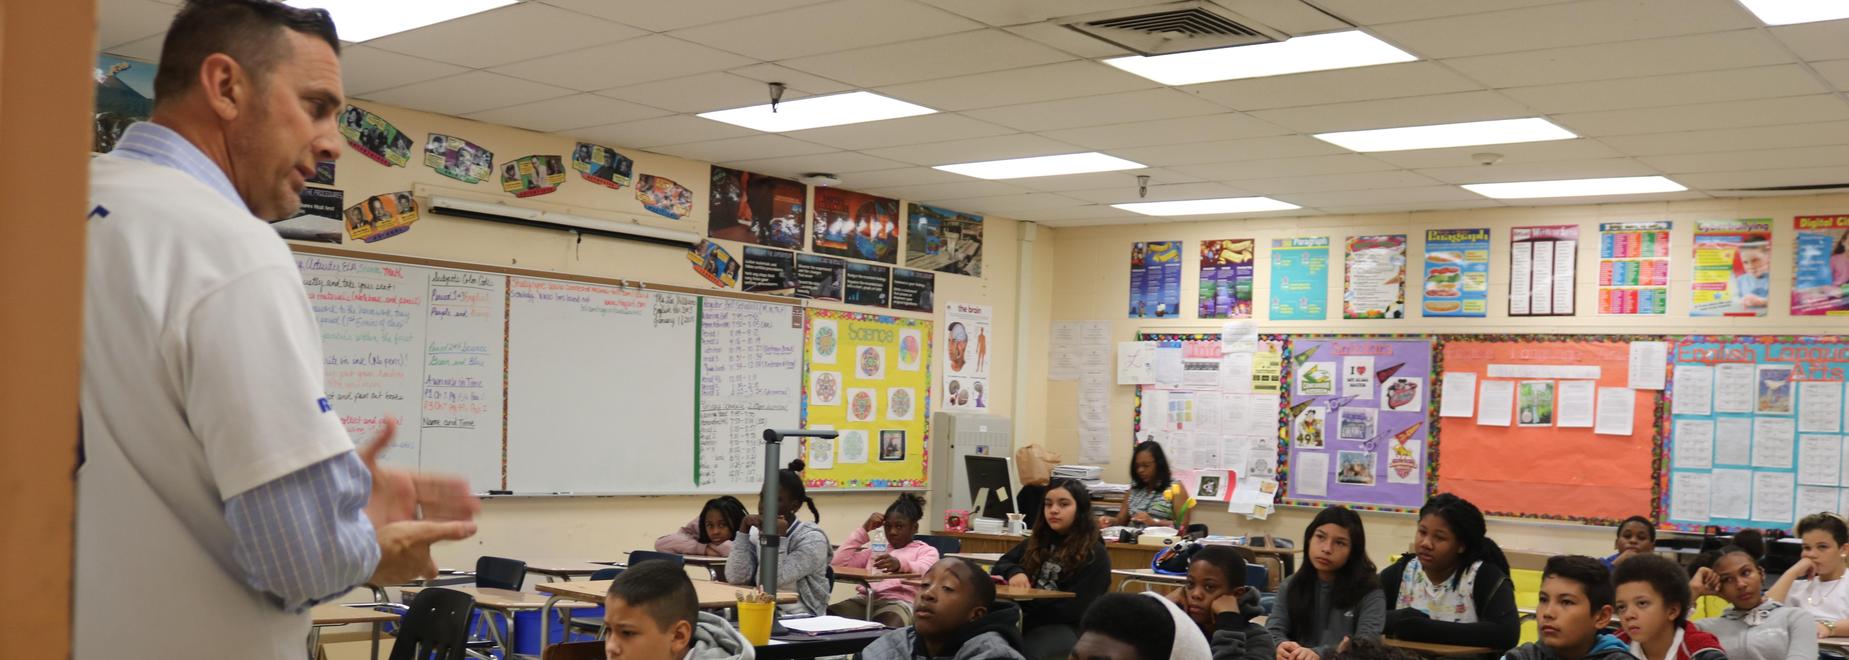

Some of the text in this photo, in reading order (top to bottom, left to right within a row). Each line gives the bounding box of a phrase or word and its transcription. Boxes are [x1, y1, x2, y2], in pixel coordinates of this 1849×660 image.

[1800, 218, 1833, 229] Digital
[1428, 229, 1488, 242] Paragraph
[957, 304, 982, 314] the brain
[848, 323, 895, 344] Science
[1677, 341, 1756, 366] English
[1350, 366, 1355, 375] I
[1788, 362, 1845, 382] Arts
